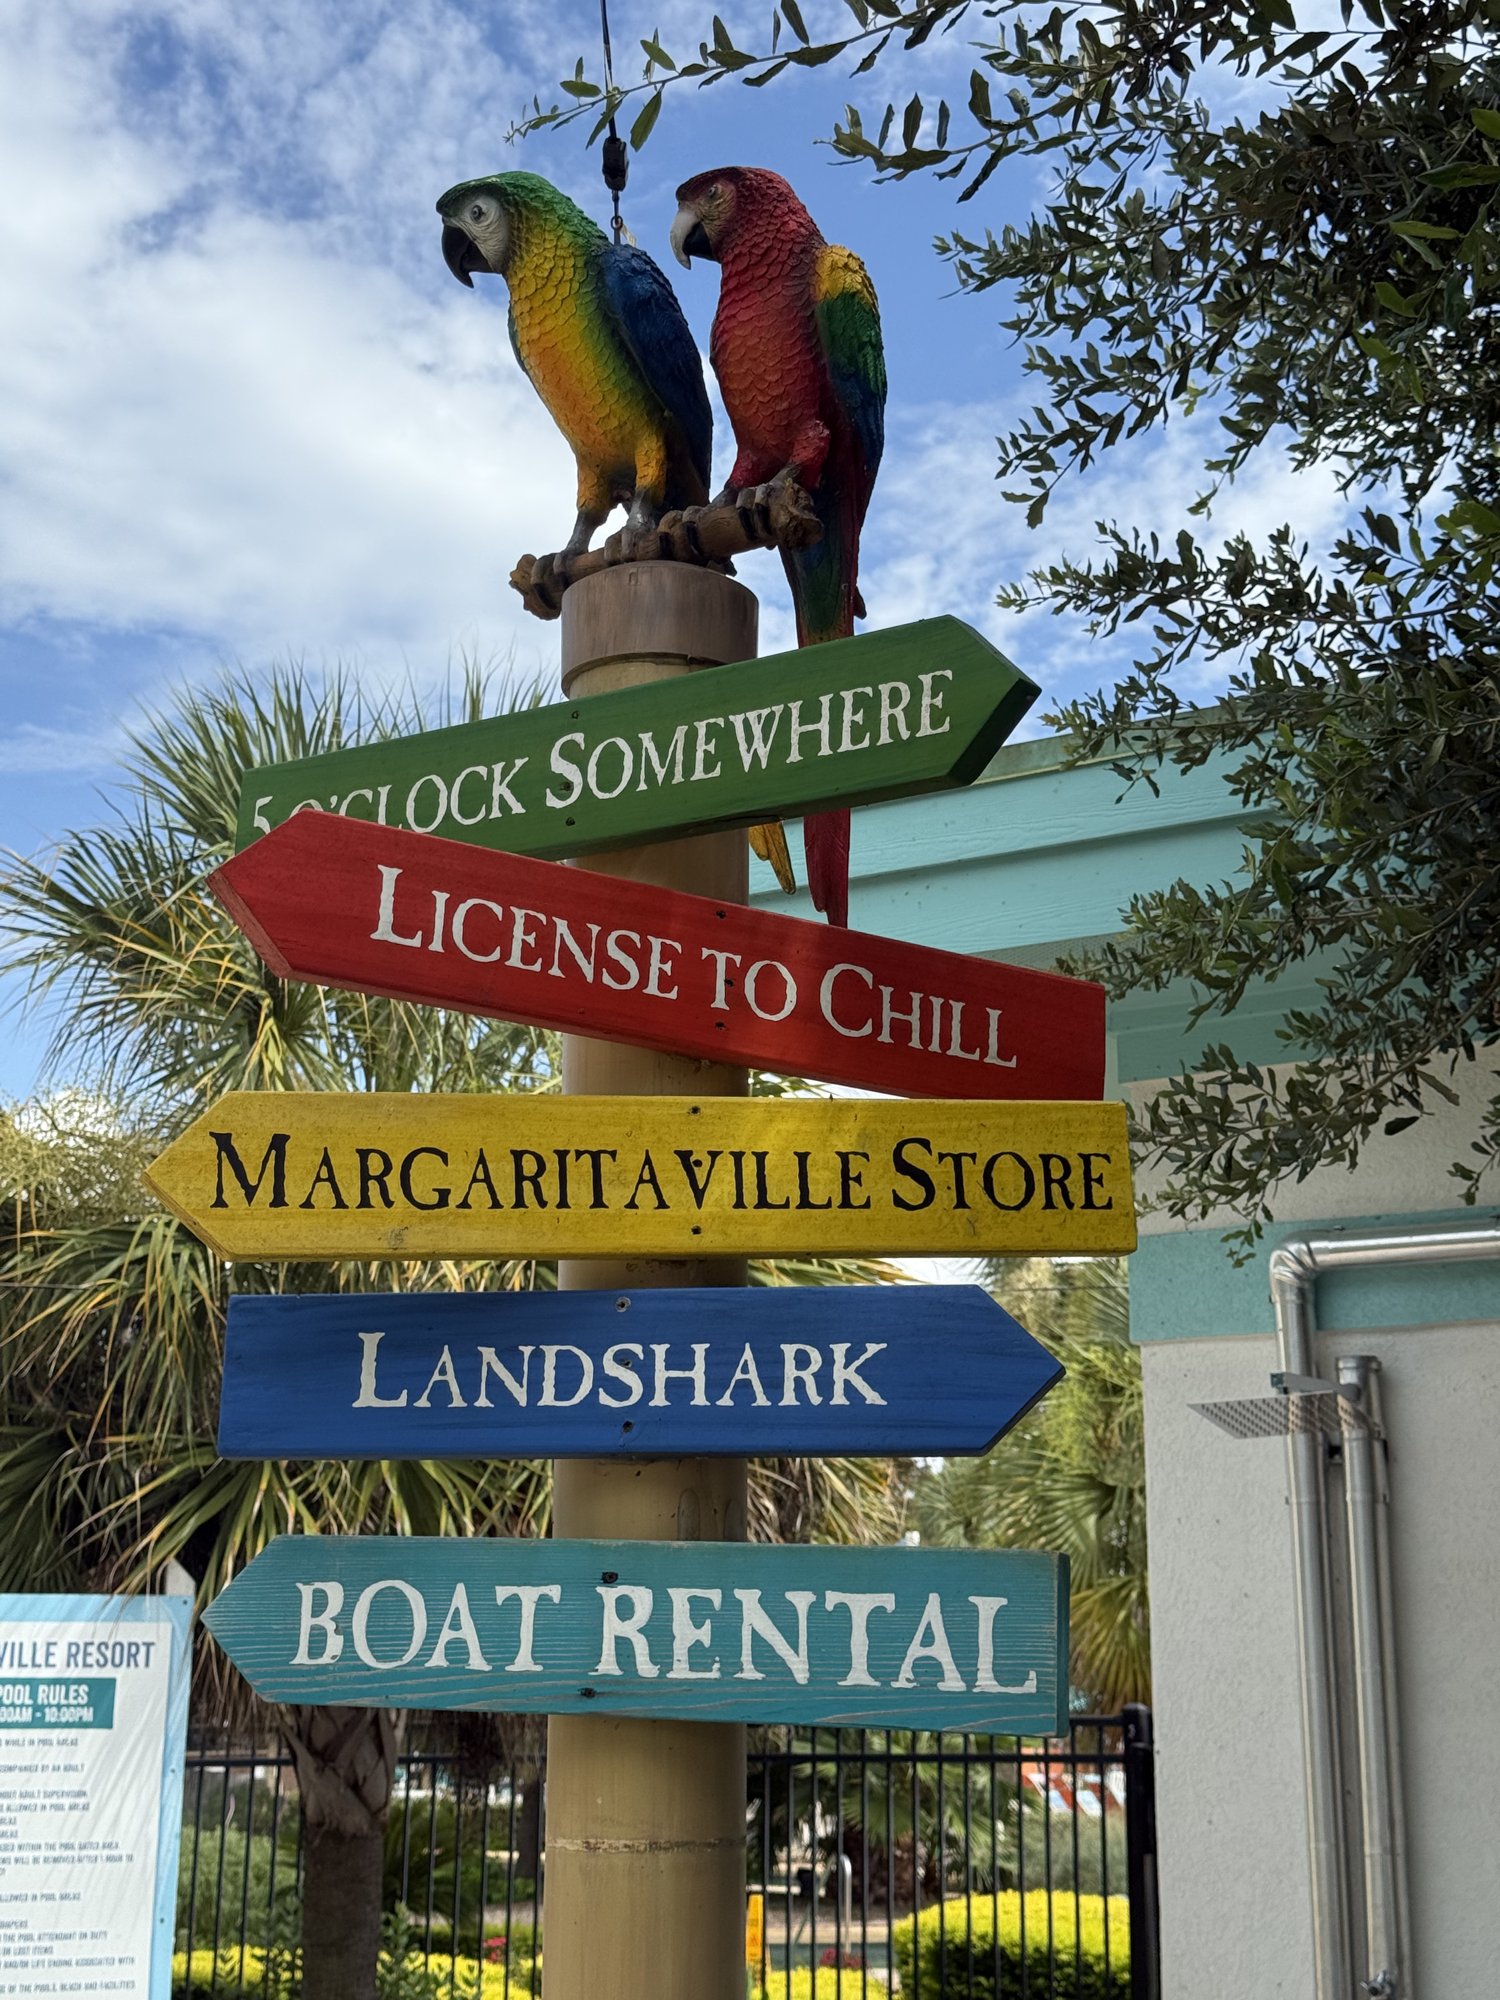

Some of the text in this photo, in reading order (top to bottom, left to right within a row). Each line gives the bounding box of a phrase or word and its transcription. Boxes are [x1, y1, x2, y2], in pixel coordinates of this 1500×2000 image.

[544, 668, 954, 811] SOMEWHERE
[369, 864, 1019, 1069] LICENSE TO CHILL
[208, 1131, 1115, 1212] MARGARITAVILLE STORE
[352, 1331, 888, 1409] LANDSHARK
[66, 1640, 156, 1668] RESORT
[291, 1580, 1039, 1695] BOAT RENTAL
[37, 1684, 90, 1706] RULES
